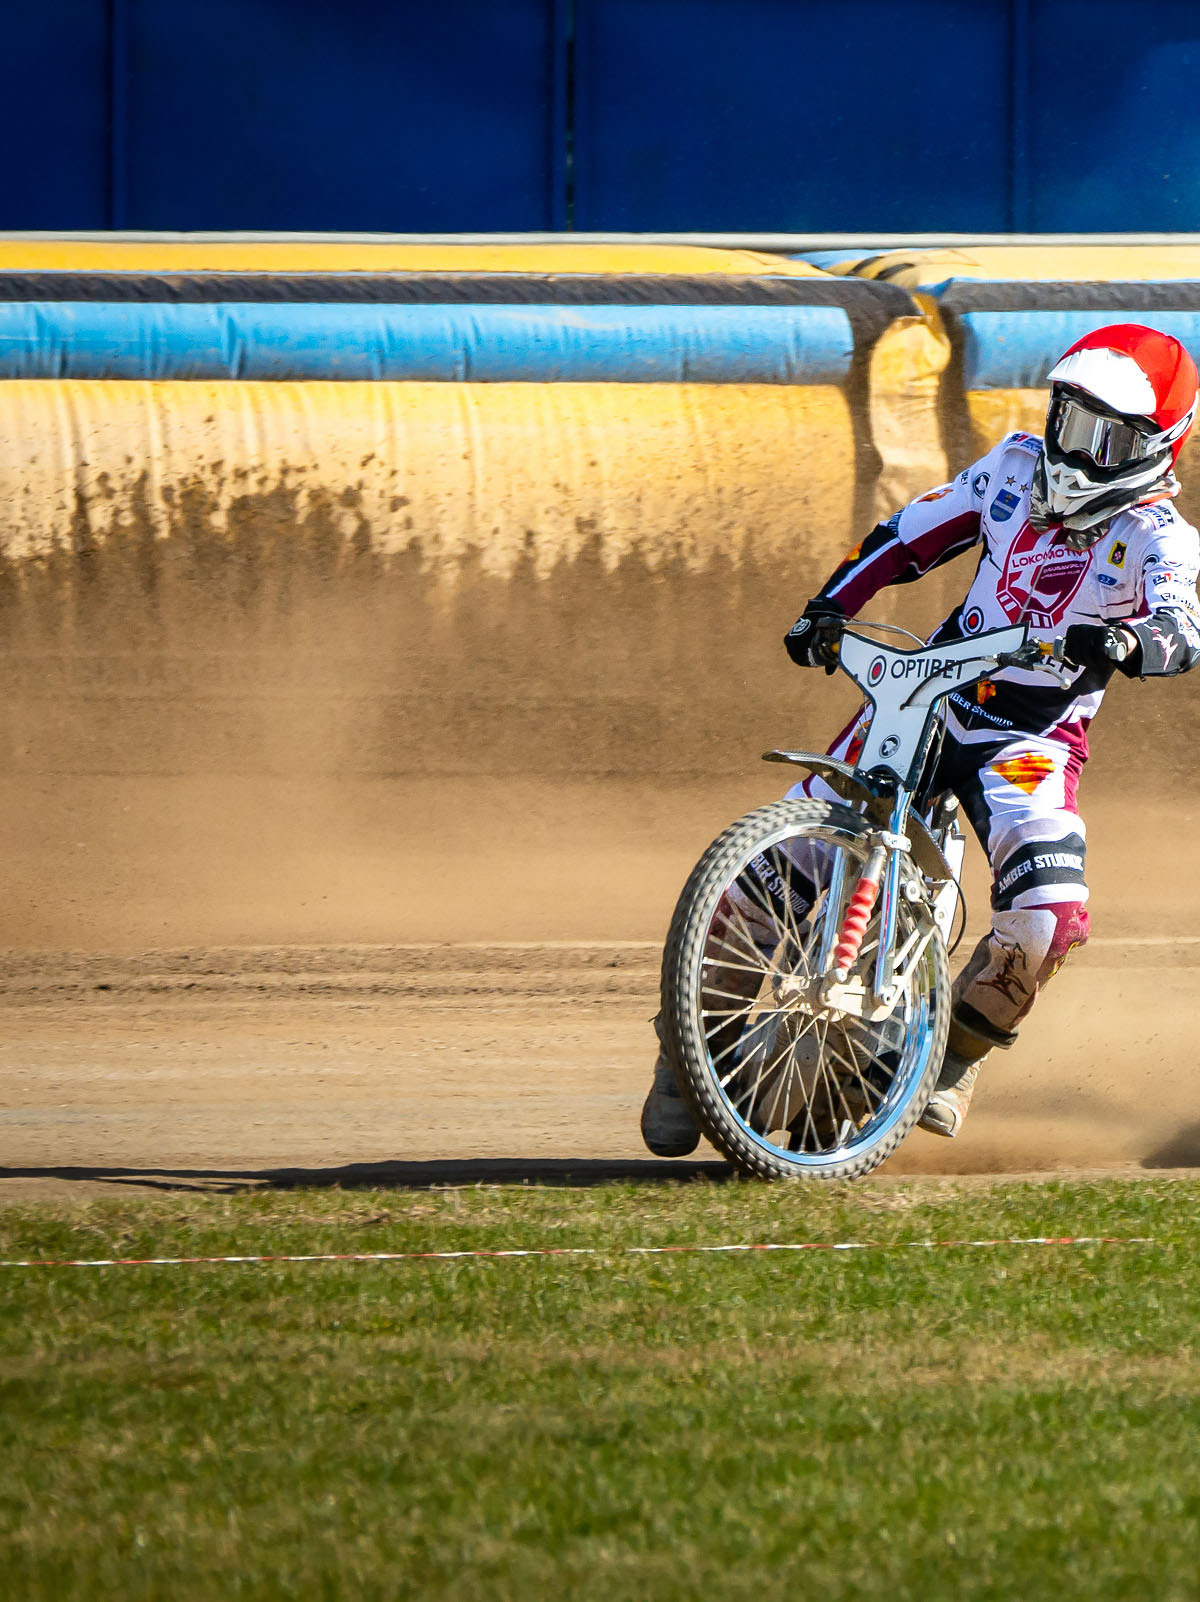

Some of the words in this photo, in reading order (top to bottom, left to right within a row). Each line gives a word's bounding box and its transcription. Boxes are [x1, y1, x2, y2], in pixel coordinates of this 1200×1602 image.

[890, 657, 964, 680] OPTIBET
[999, 859, 1034, 894] AMBER
[1033, 852, 1084, 873] STUDIOS
